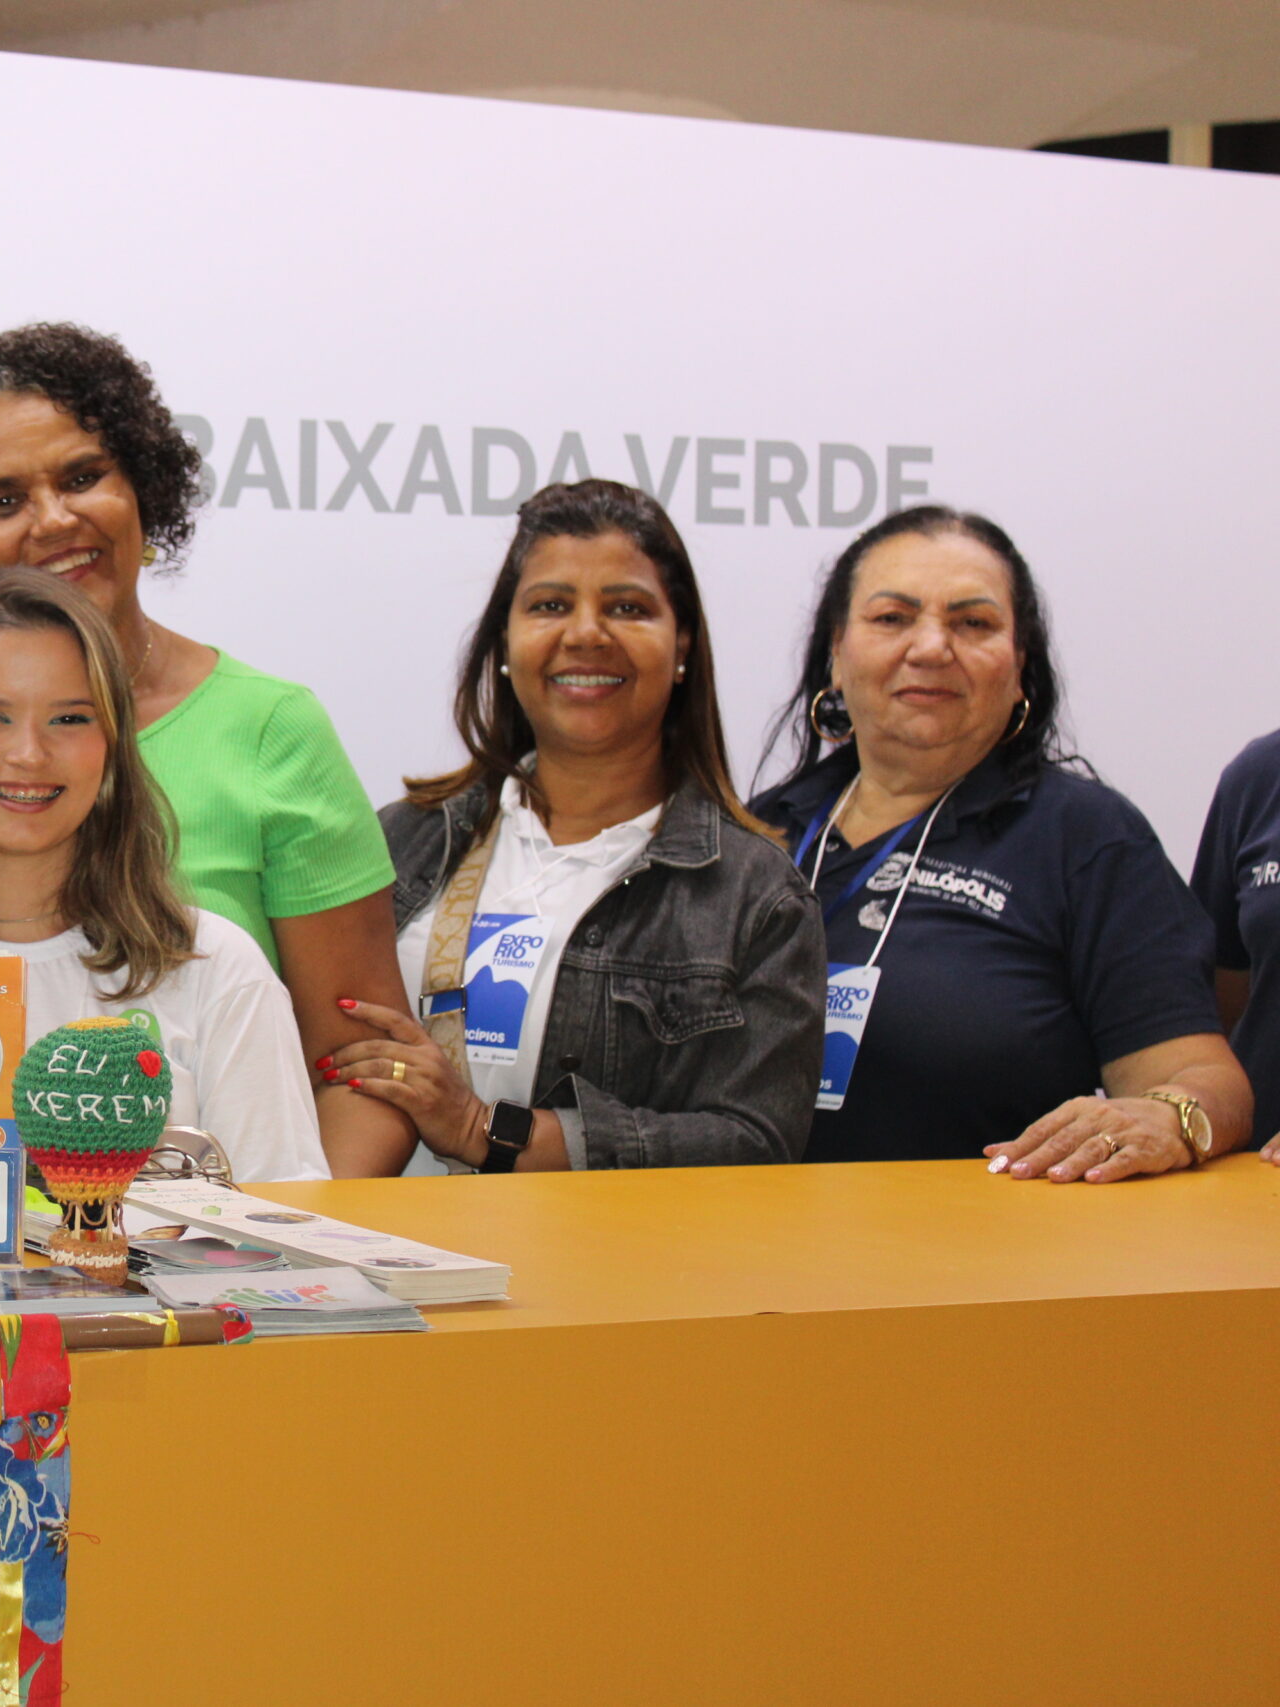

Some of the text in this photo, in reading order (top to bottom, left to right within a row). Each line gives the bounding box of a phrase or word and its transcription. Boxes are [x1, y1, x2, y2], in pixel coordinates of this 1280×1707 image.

[624, 433, 934, 529] VERDE
[907, 866, 1007, 912] NILÓPOLIS
[499, 934, 544, 949] EXPO
[494, 944, 527, 960] RIO
[493, 958, 535, 968] TURISMO
[826, 985, 870, 1001] EXPO
[826, 1011, 863, 1021] URISMO
[464, 1028, 505, 1043] ICÍPIOS
[48, 1044, 108, 1076] EU
